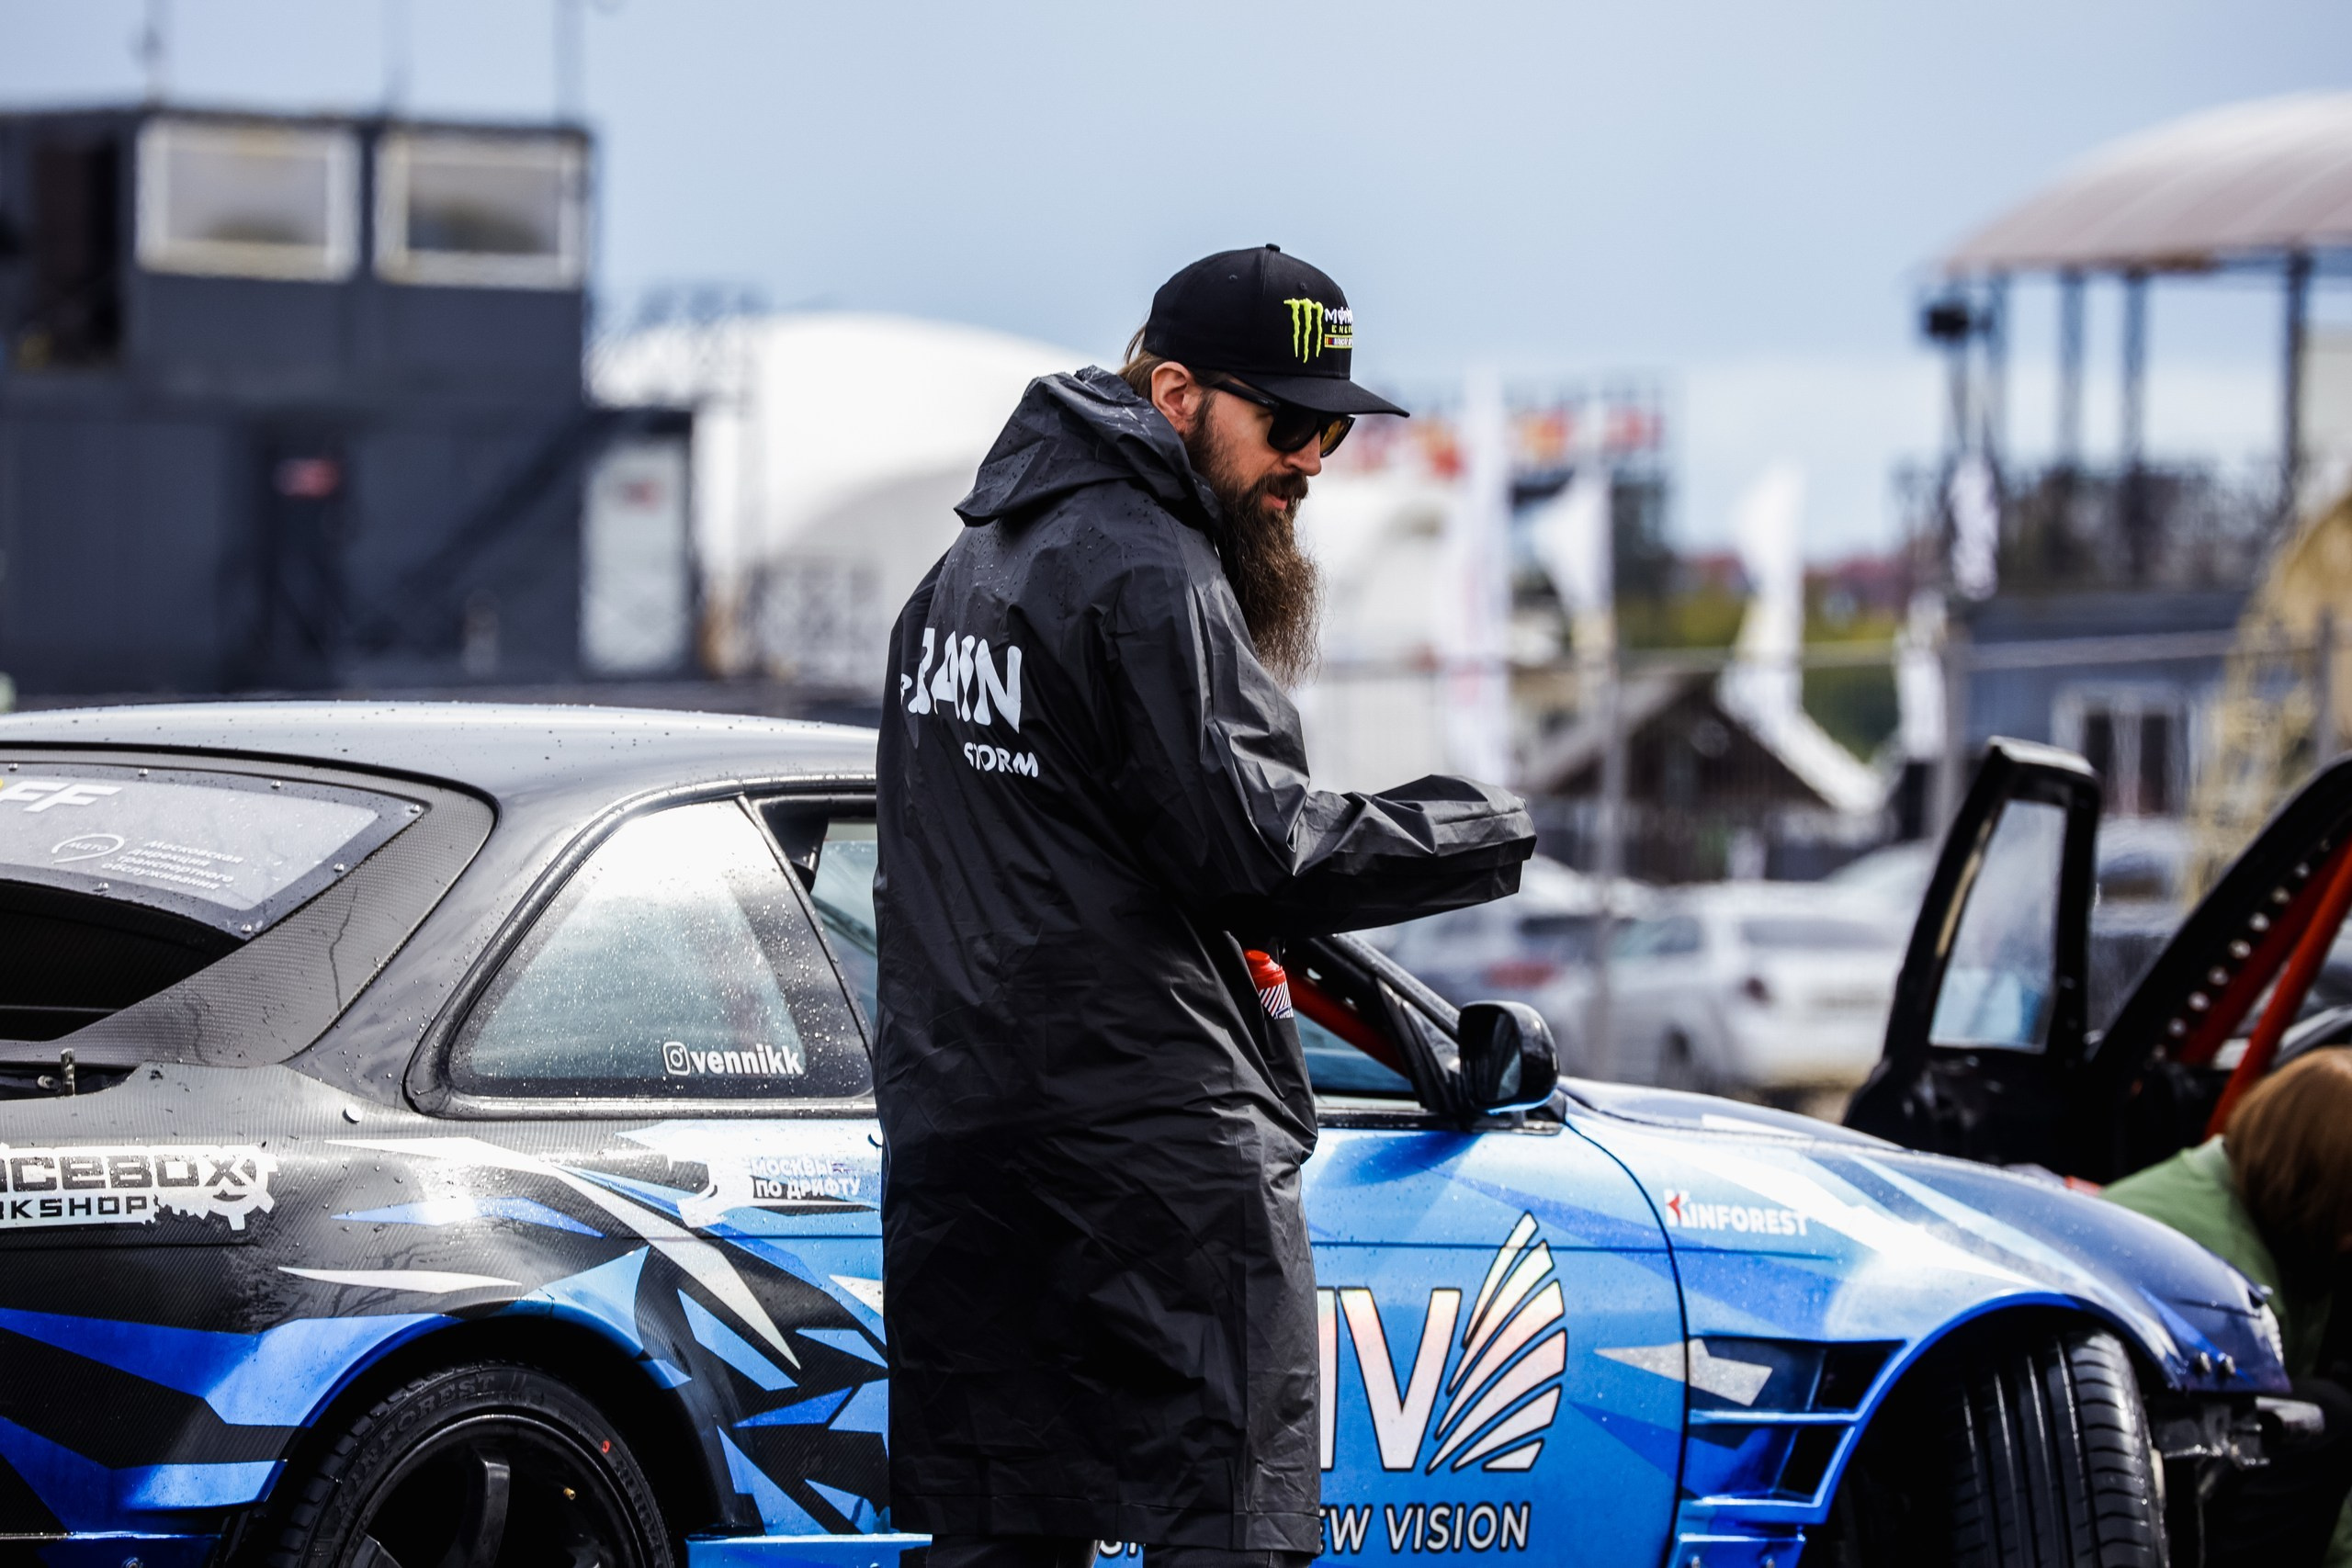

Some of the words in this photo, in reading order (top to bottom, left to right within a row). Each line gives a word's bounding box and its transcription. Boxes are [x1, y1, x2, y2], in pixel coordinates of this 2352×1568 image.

[144, 840, 244, 864] Московская
[101, 862, 220, 890] обслуживания
[690, 1043, 804, 1075] vennikk
[750, 1158, 833, 1179] МОСКВЫ
[755, 1179, 782, 1198] ПО
[787, 1178, 861, 1200] ДРИФТУ
[1385, 1505, 1530, 1551] VISION
